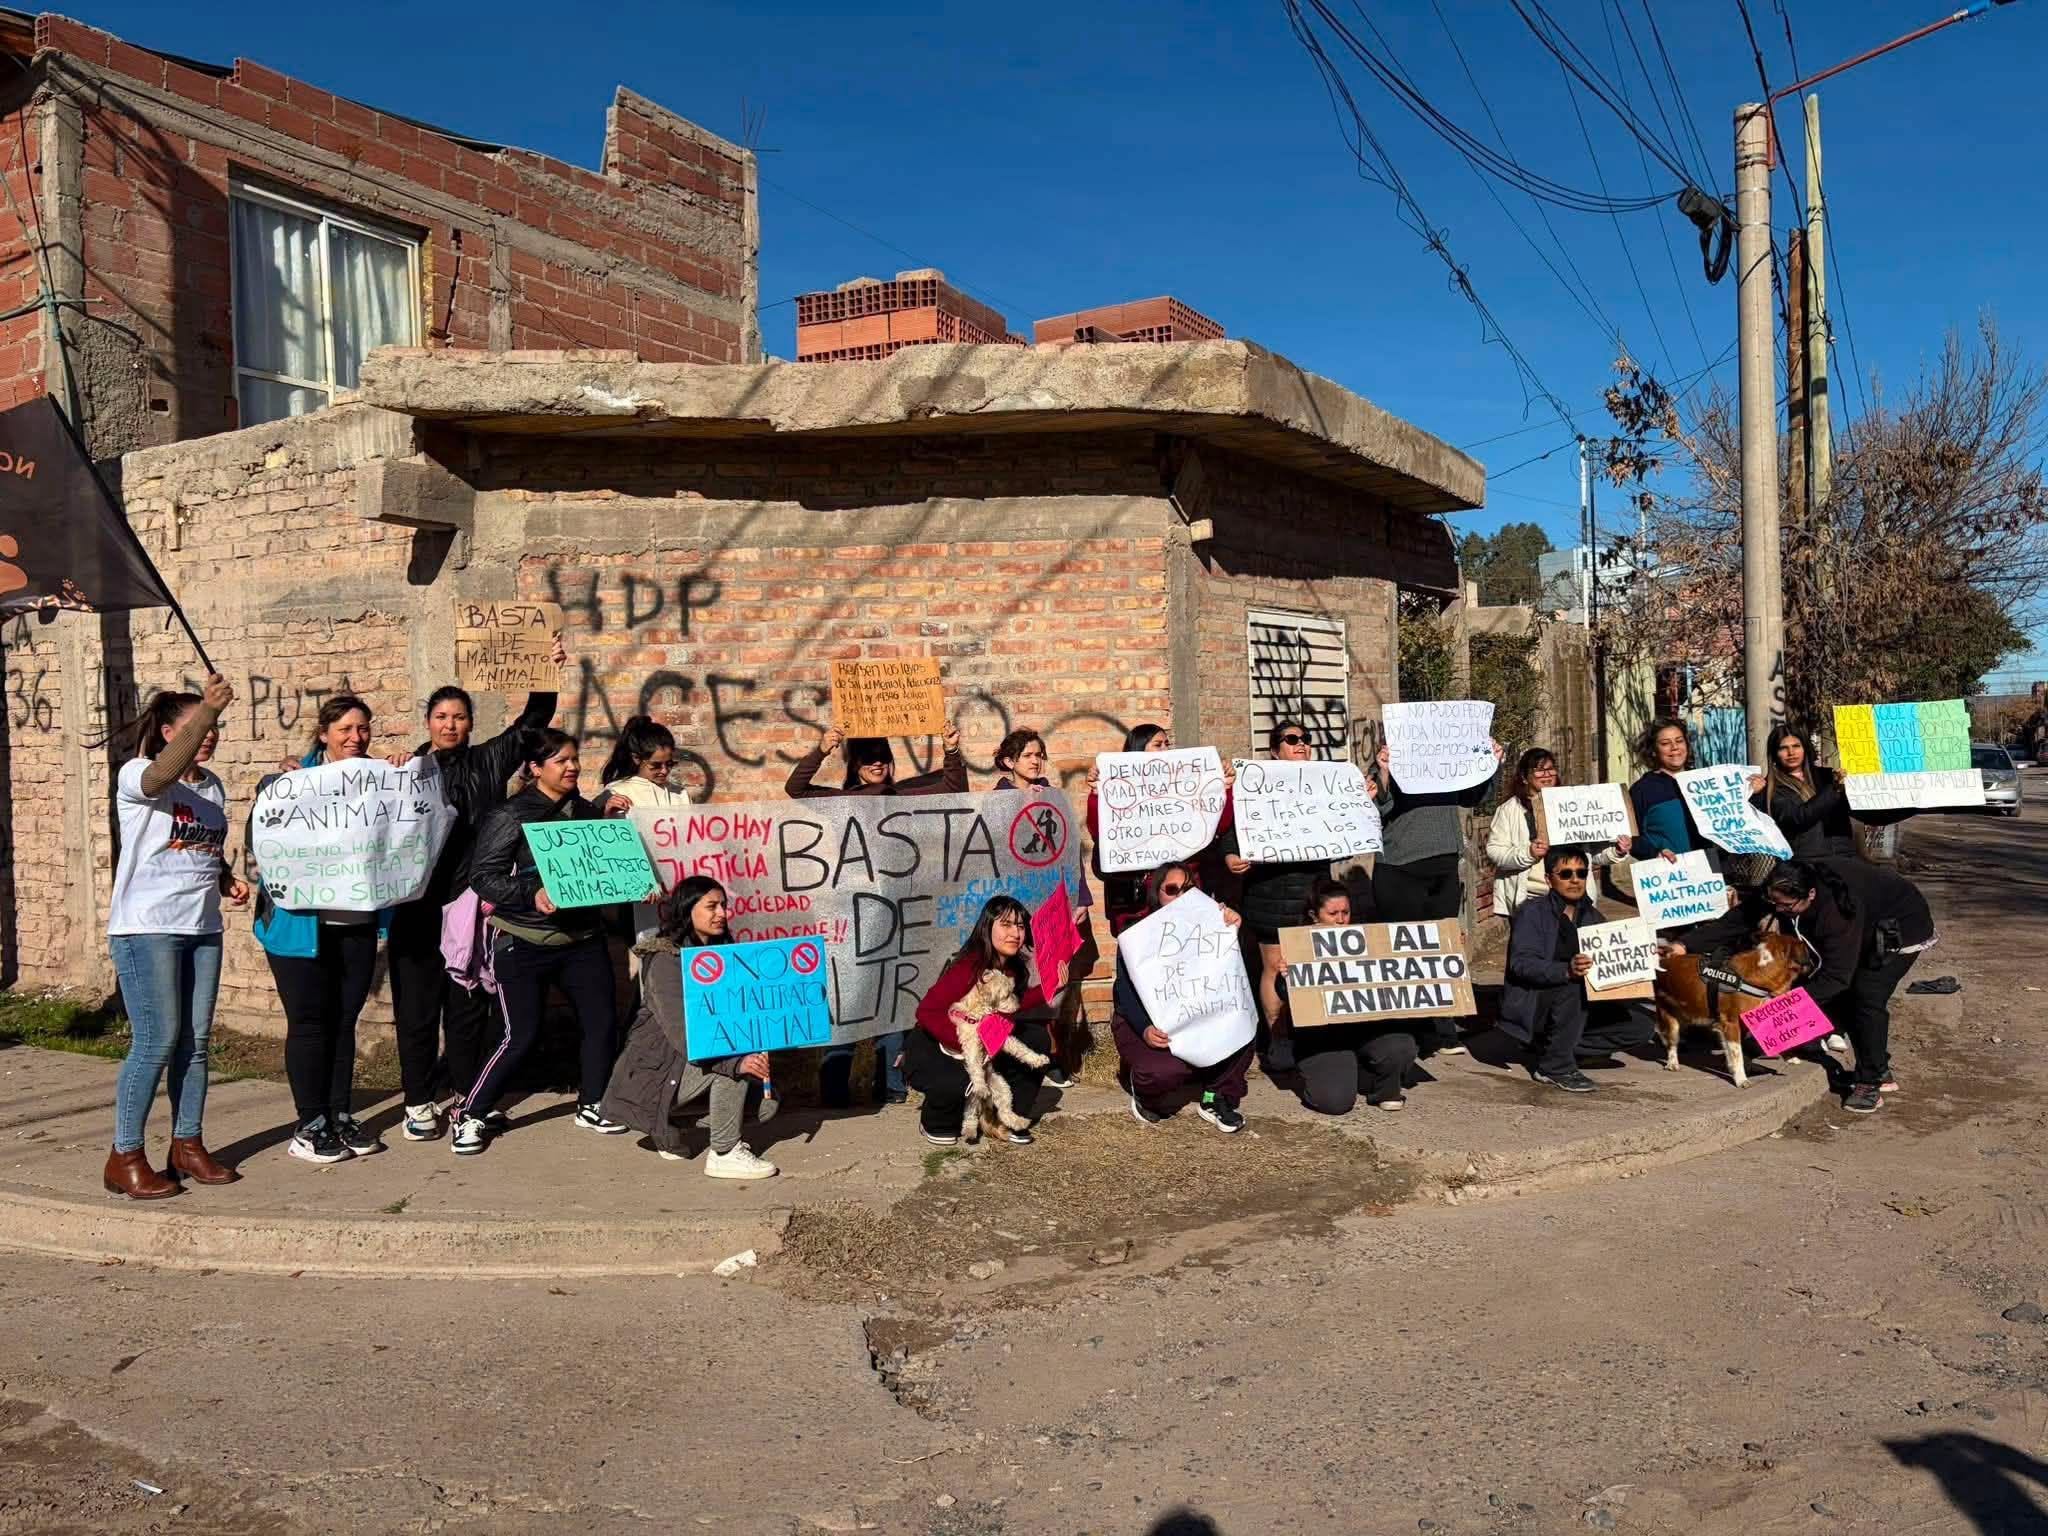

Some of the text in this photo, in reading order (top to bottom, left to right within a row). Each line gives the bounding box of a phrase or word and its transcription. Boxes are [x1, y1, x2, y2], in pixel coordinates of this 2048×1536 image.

[1109, 757, 1216, 779] DENUNCIA EL
[1104, 780, 1197, 799] MALTRATO
[1686, 771, 1744, 795] QUE LA
[1726, 787, 1743, 801] TE
[1111, 808, 1134, 823] NO
[1559, 800, 1604, 813] NO AL
[1701, 801, 1745, 819] TRATE
[686, 813, 729, 844] NO
[734, 812, 772, 845] HAY
[1558, 811, 1625, 829] MALTRATO
[1107, 822, 1192, 841] OTRO LADO
[1564, 829, 1612, 843] ANIMAL
[580, 845, 604, 860] NO
[778, 808, 1000, 892] BASTA
[547, 858, 570, 878] AL
[1640, 870, 1687, 890] NO AL
[293, 883, 336, 905] NO
[1648, 880, 1724, 904] MALTRATO
[1661, 901, 1715, 920] ANIMAL
[852, 892, 933, 957] DE
[1312, 924, 1440, 957] NO AL
[1581, 932, 1628, 952] NO AL
[732, 946, 788, 981] NO
[1164, 961, 1185, 984] DE
[1288, 955, 1465, 987] MALTRATO
[1597, 959, 1648, 980] ANIMAL
[1702, 967, 1737, 983] POLICE K9
[700, 981, 827, 1016] AL MALTRATO
[1330, 983, 1453, 1014] ANIMAL
[711, 1008, 827, 1052] ANIMAL
